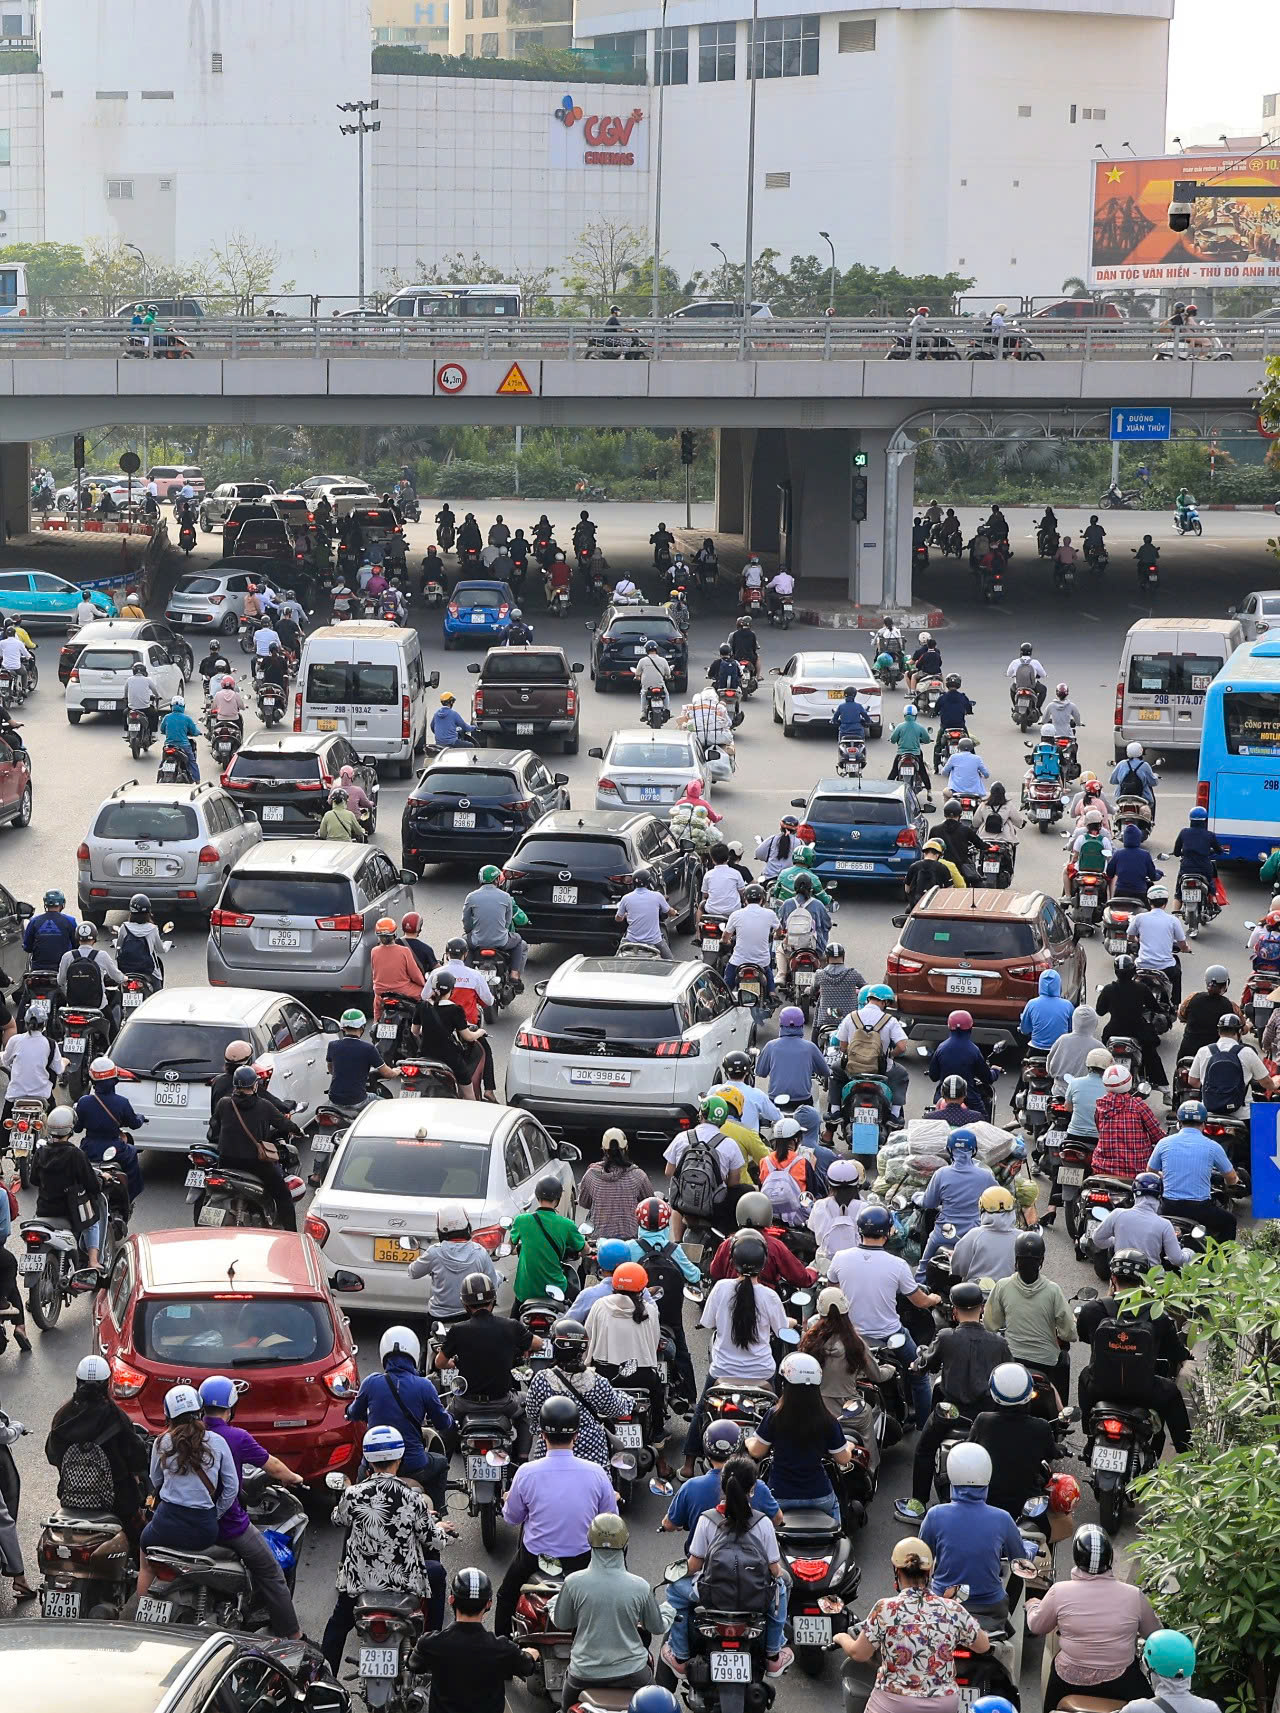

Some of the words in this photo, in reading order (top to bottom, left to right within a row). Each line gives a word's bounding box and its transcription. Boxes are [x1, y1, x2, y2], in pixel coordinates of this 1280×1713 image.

[584, 115, 635, 146] CGV
[585, 152, 634, 166] CINEMAS
[1265, 159, 1280, 170] 10.
[1096, 268, 1117, 281] DÂN
[1120, 268, 1139, 282] TỘC
[1242, 266, 1265, 277] ANH
[1129, 413, 1154, 422] ĐƯỜNG
[1126, 423, 1146, 432] XUÂN
[1148, 422, 1166, 432] THỦY
[1154, 695, 1169, 705] 29B
[1177, 695, 1203, 705] 174.07
[351, 706, 372, 714] 193.42
[1244, 719, 1262, 729] CÔNG
[1263, 720, 1271, 729] TY
[1264, 780, 1280, 790] 29B
[558, 887, 572, 895] 30F
[278, 930, 292, 938] 30G
[576, 1070, 626, 1081] 30K-998.64
[164, 1084, 181, 1093] 30G
[157, 1094, 187, 1104] 005.18
[379, 1250, 414, 1262] 366.22
[1098, 1448, 1122, 1460] 29-U1
[1094, 1459, 1124, 1471] 423.51
[472, 1469, 497, 1479] 2996
[50, 1592, 75, 1605] 37-B1
[46, 1604, 77, 1618] 349.89
[142, 1600, 167, 1614] 38-H1
[799, 1618, 825, 1630] 29-L1
[796, 1631, 829, 1643] 915.74
[365, 1651, 393, 1663] 29-Y3
[717, 1654, 744, 1667] 29-P1
[362, 1663, 396, 1676] 241.03
[714, 1668, 749, 1680] 799.84
